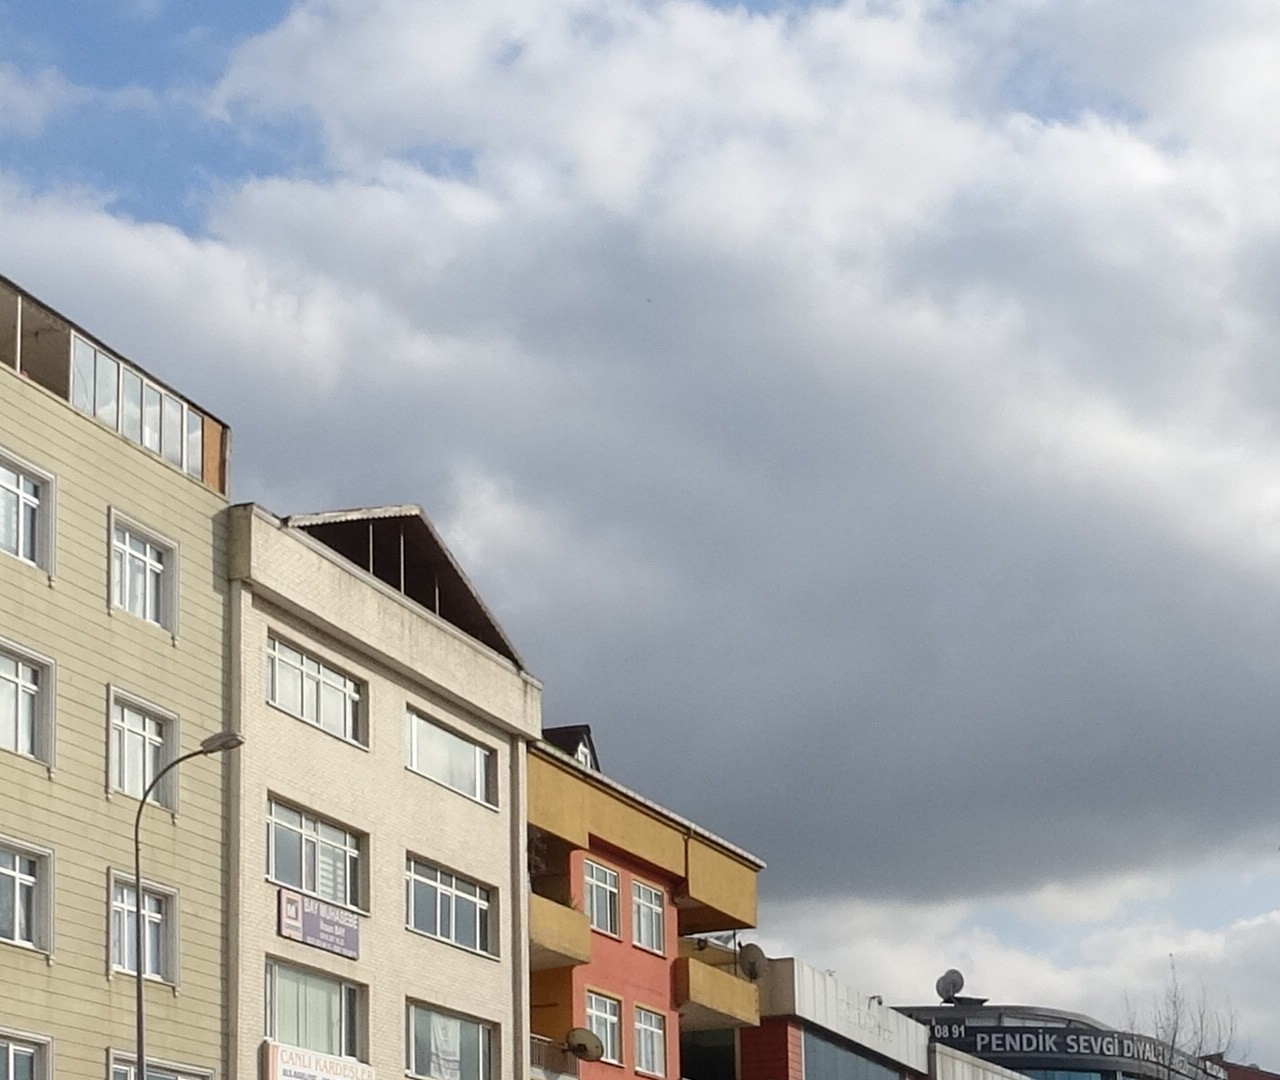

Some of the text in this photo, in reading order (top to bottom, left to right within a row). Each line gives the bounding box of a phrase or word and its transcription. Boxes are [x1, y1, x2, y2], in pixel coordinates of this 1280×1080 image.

[303, 897, 319, 915] BAY
[319, 903, 359, 930] MUHASEBE
[934, 1023, 966, 1039] 08 91
[976, 1028, 1058, 1053] PENDİK
[1066, 1031, 1119, 1056] SEVGİ
[280, 1049, 312, 1070] CANLI
